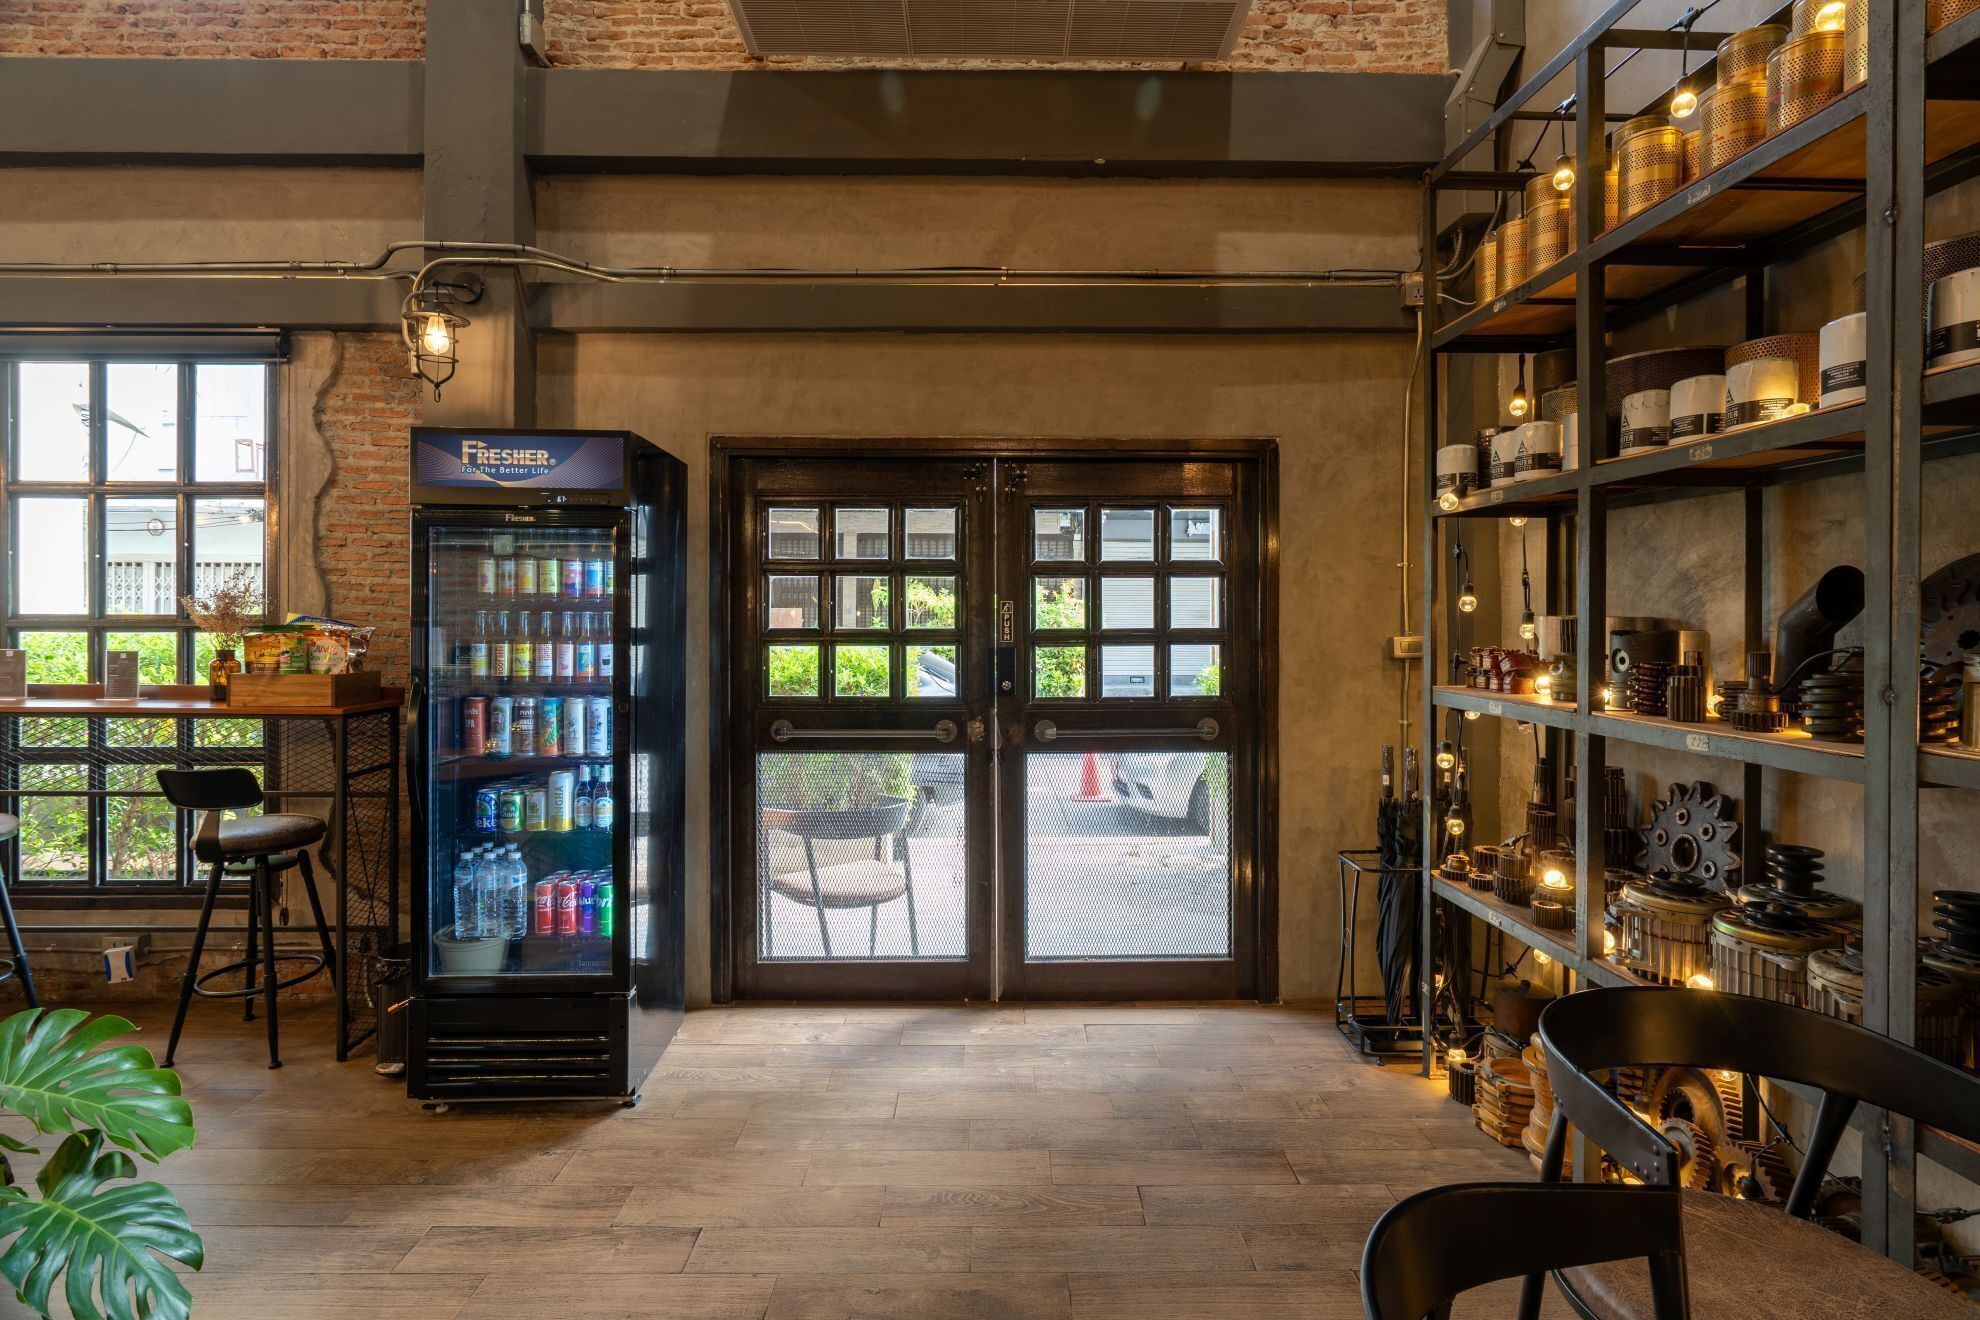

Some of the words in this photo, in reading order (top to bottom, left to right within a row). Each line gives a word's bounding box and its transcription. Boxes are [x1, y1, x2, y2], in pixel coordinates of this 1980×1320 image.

[461, 440, 549, 466] FRESHER
[461, 466, 477, 474] For
[479, 466, 496, 474] The
[499, 466, 528, 475] Better
[531, 467, 550, 475] Life
